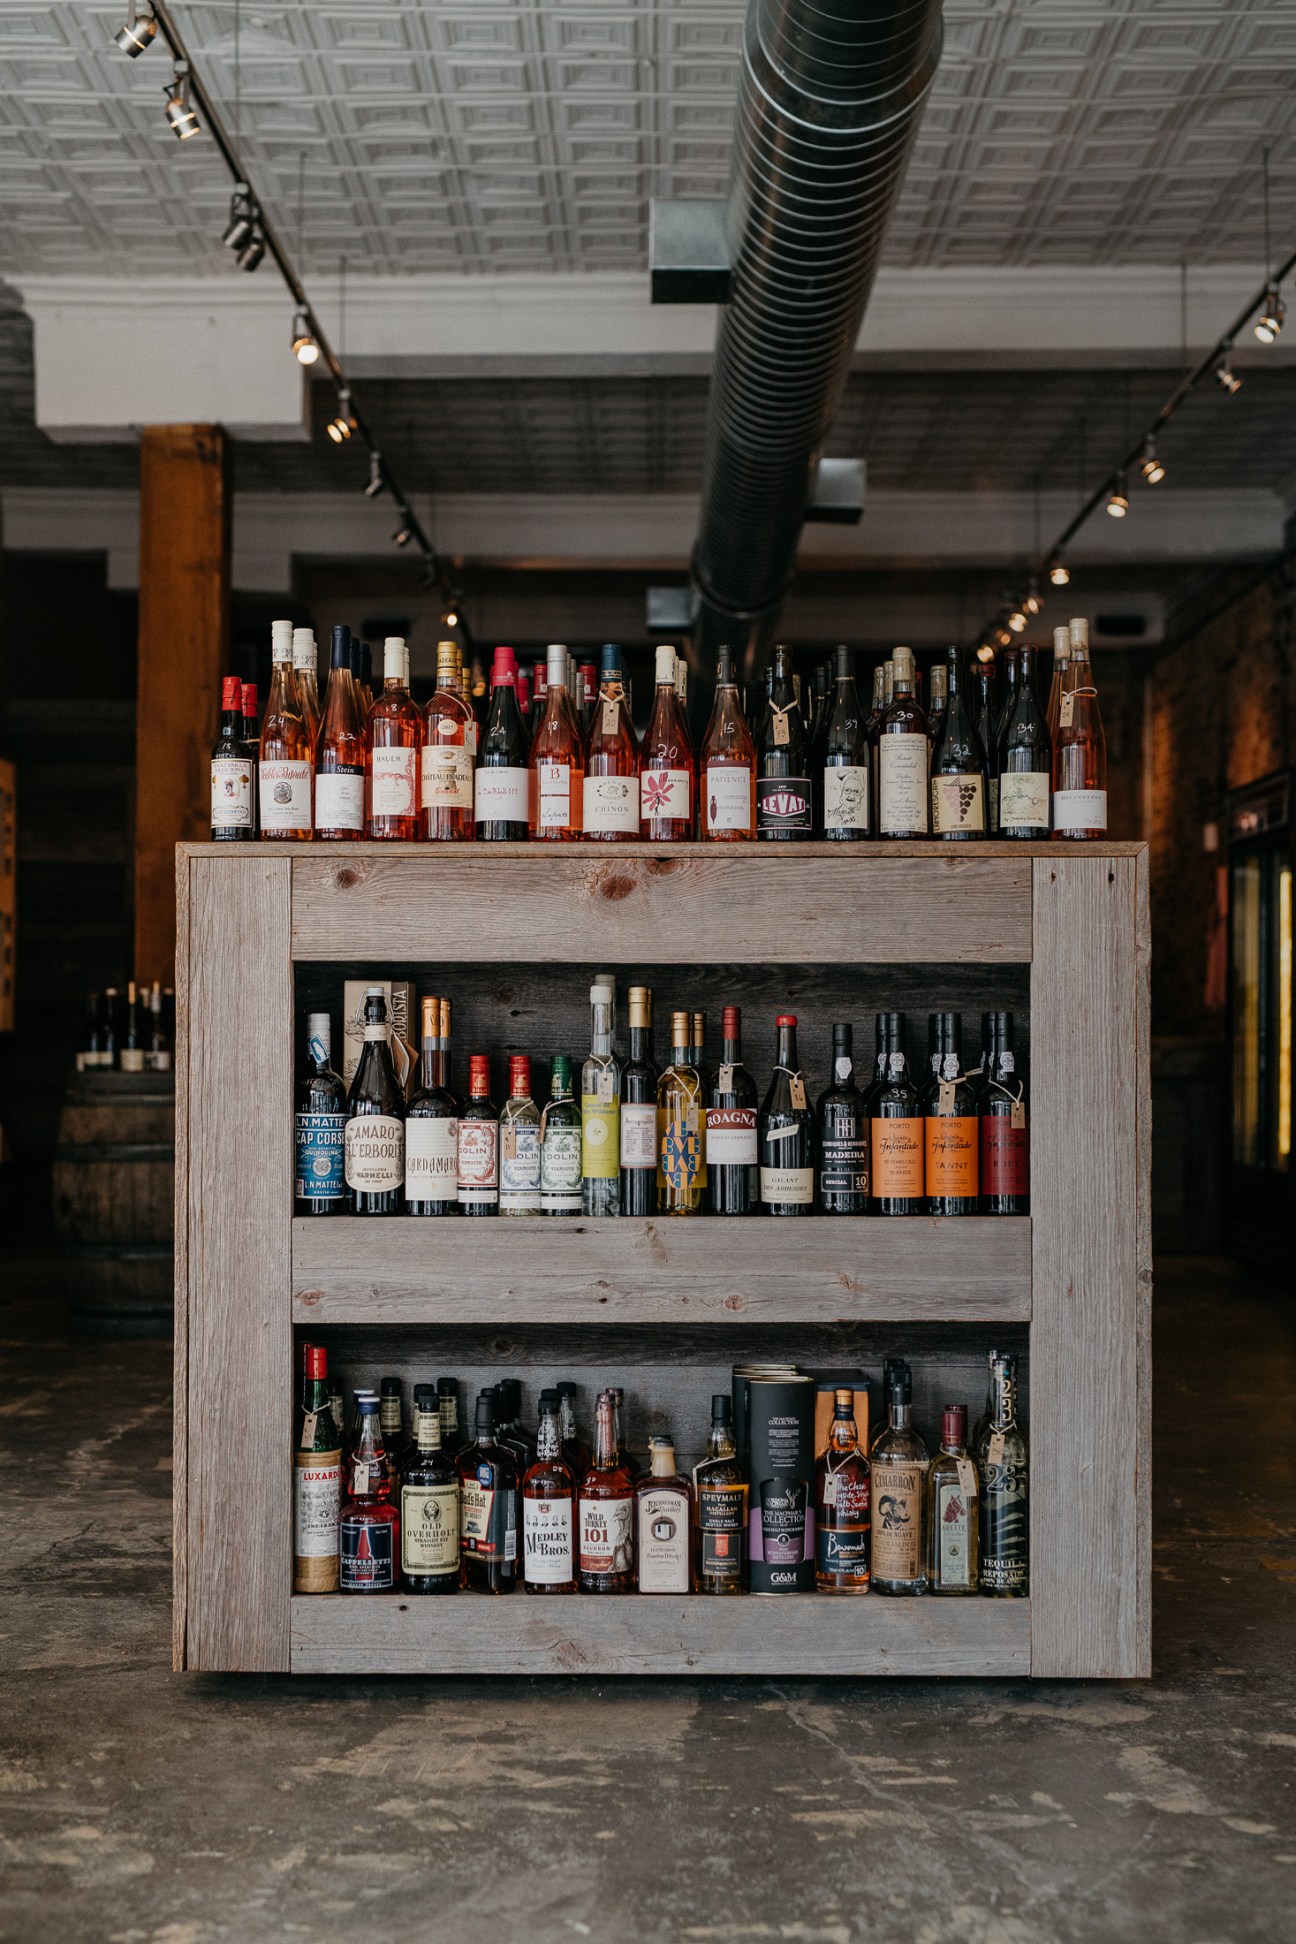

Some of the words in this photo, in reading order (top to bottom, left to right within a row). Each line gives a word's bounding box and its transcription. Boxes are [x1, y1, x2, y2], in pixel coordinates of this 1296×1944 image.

[385, 703, 397, 712] 18
[267, 714, 285, 728] 24
[896, 710, 914, 722] 30
[547, 720, 558, 731] 18
[723, 722, 735, 734] 15
[1017, 723, 1036, 734] 34
[338, 732, 356, 740] 22
[490, 726, 506, 737] 24
[657, 743, 678, 759] 20
[952, 744, 972, 757] 32
[376, 755, 401, 763] BAUER
[336, 765, 355, 774] Stein
[763, 793, 806, 815] LEVAT
[707, 1111, 755, 1128] ROAGNA
[354, 1125, 395, 1140] AMARO
[296, 1132, 313, 1145] CAP
[317, 1132, 345, 1145] CORSE
[825, 1151, 865, 1159] MADEIRA
[855, 1176, 867, 1186] 10
[303, 1471, 341, 1481] LUXARDO
[987, 1465, 1019, 1493] 23
[874, 1473, 916, 1492] CIMARRON
[474, 1493, 486, 1508] Hat
[702, 1493, 742, 1502] SPEYMALT
[645, 1500, 681, 1513] JOURNEYMAN
[586, 1512, 604, 1521] WILD
[763, 1514, 805, 1524] OLLECTION
[422, 1522, 442, 1530] OLD
[583, 1517, 607, 1529] TURKEY
[407, 1528, 456, 1538] OVERHOLT
[584, 1529, 609, 1543] 101
[526, 1532, 568, 1556] MEDLEY
[537, 1542, 570, 1556] BROS.
[856, 1567, 865, 1575] 10
[770, 1572, 797, 1583] G&M
